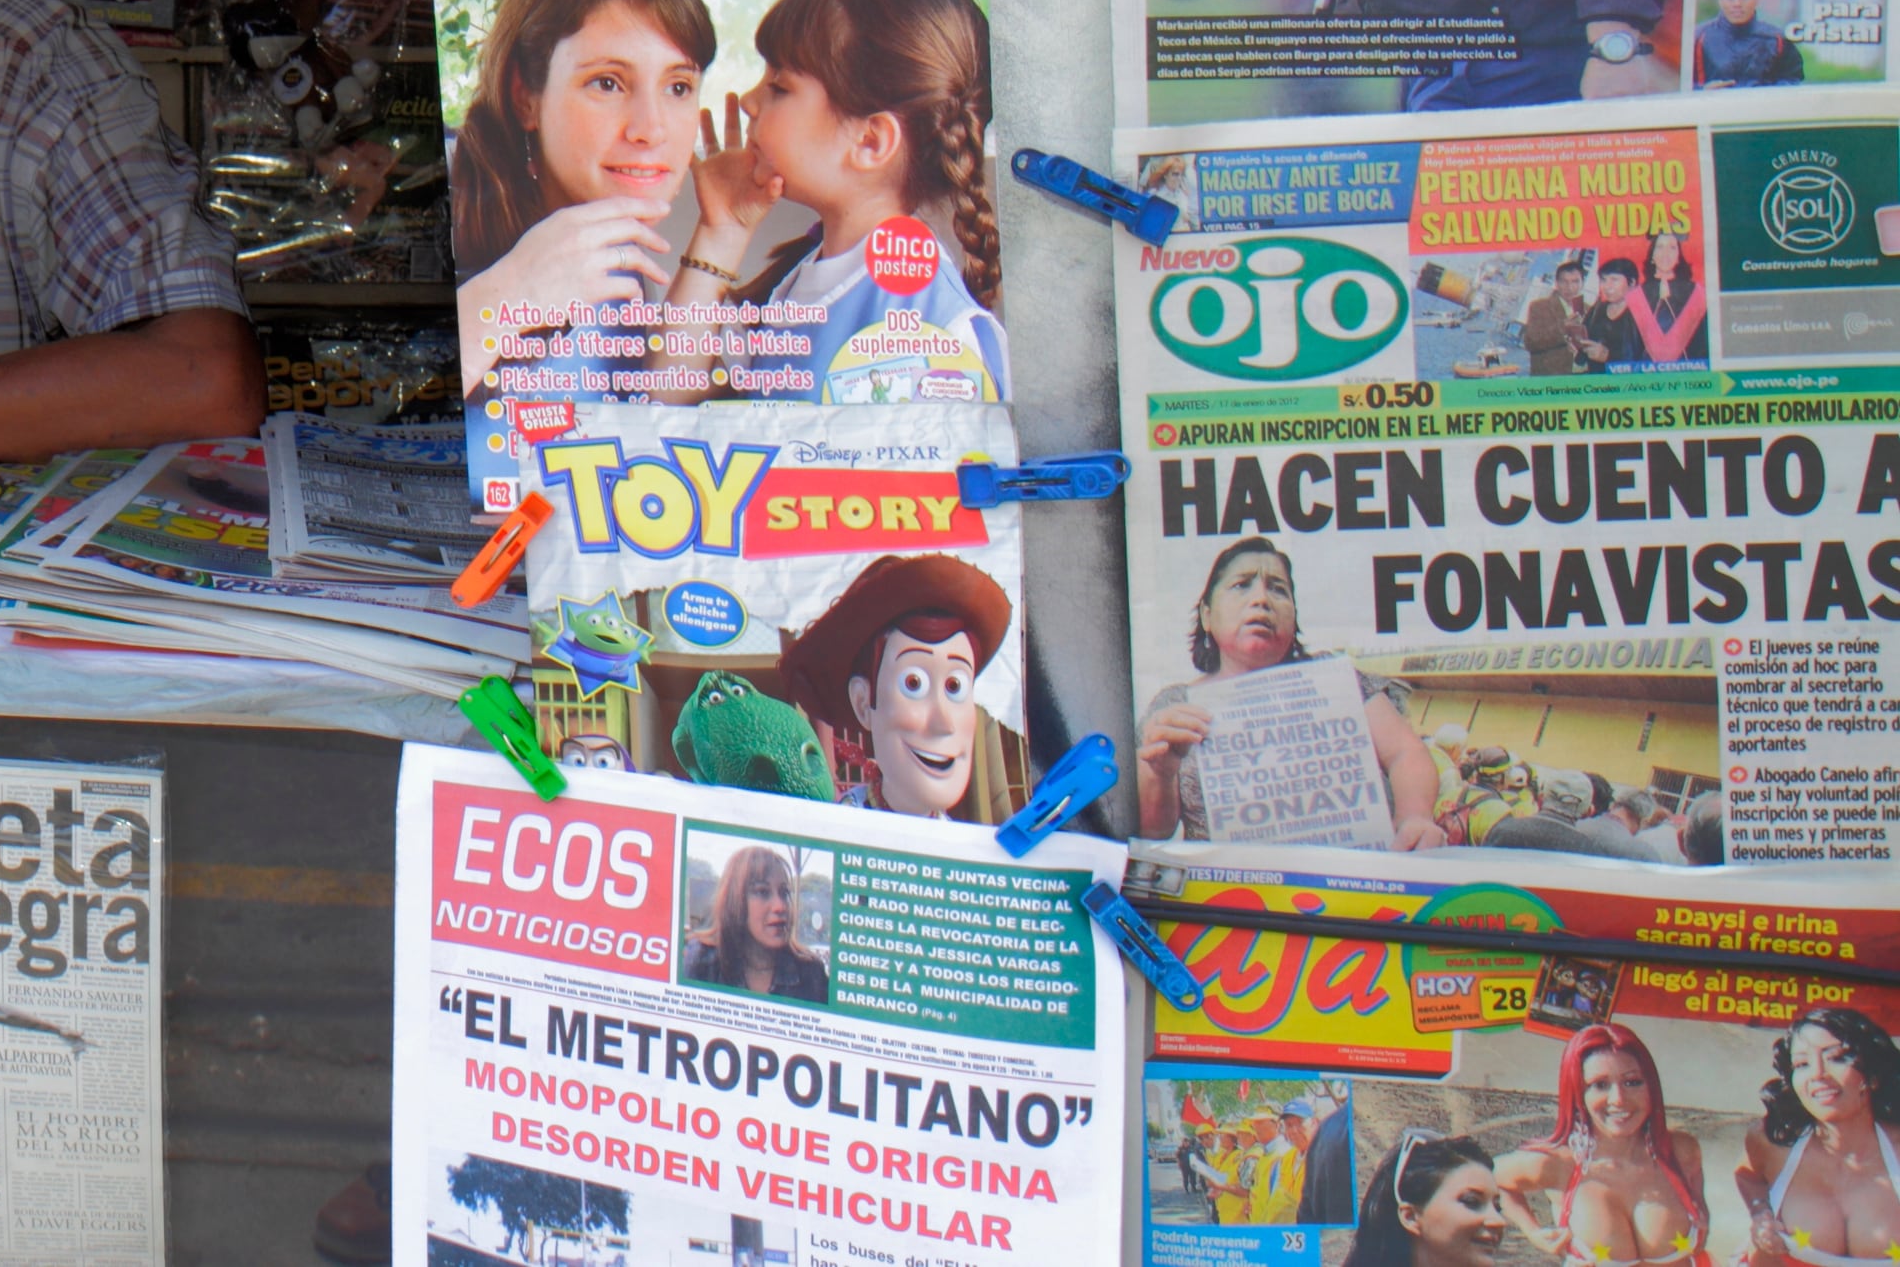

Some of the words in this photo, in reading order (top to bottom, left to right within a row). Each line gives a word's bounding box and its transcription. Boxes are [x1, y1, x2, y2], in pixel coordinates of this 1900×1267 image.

[1784, 21, 1882, 44] Cristal
[1419, 164, 1569, 204] PERUANA
[1579, 160, 1686, 198] MURIO
[1420, 205, 1584, 246] SALVANDO
[1594, 201, 1691, 237] VIDAS
[1786, 197, 1830, 219] SOL
[871, 228, 936, 259] Cinco
[1140, 245, 1236, 272] Nuevo
[874, 255, 932, 281] posters
[1159, 246, 1399, 369] ojo
[730, 366, 813, 395] Carpetas
[519, 405, 567, 423] REVISTA
[522, 415, 568, 430] OFICIAL
[877, 446, 941, 461] PIXAR
[1160, 447, 1445, 537] HACEN
[1475, 435, 1827, 529] CUENTO
[766, 494, 961, 532] STORY
[1725, 658, 1788, 676] comisión
[1792, 658, 1809, 674] ad
[1814, 658, 1839, 673] hoc
[1844, 660, 1877, 676] para
[1200, 717, 1358, 756] REGLAMENTO
[1212, 782, 1379, 831] FONAVI
[453, 805, 654, 912] ECOS
[435, 898, 670, 966] NOTICIOSOS
[1674, 909, 1747, 937] Daysi
[1753, 914, 1769, 933] e
[1775, 911, 1839, 936] Irina
[838, 932, 924, 956] ALCALDESA
[928, 946, 992, 967] JESSICA
[996, 956, 1061, 973] VARGAS
[1417, 975, 1473, 999] HOY
[1493, 987, 1527, 1012] 28
[464, 1057, 721, 1140] MONOPOLIO
[736, 1116, 831, 1165] QUE
[846, 1139, 1059, 1204] ORIGINA
[491, 1110, 721, 1192] DESORDEN
[735, 1164, 1013, 1252] VEHICULAR
